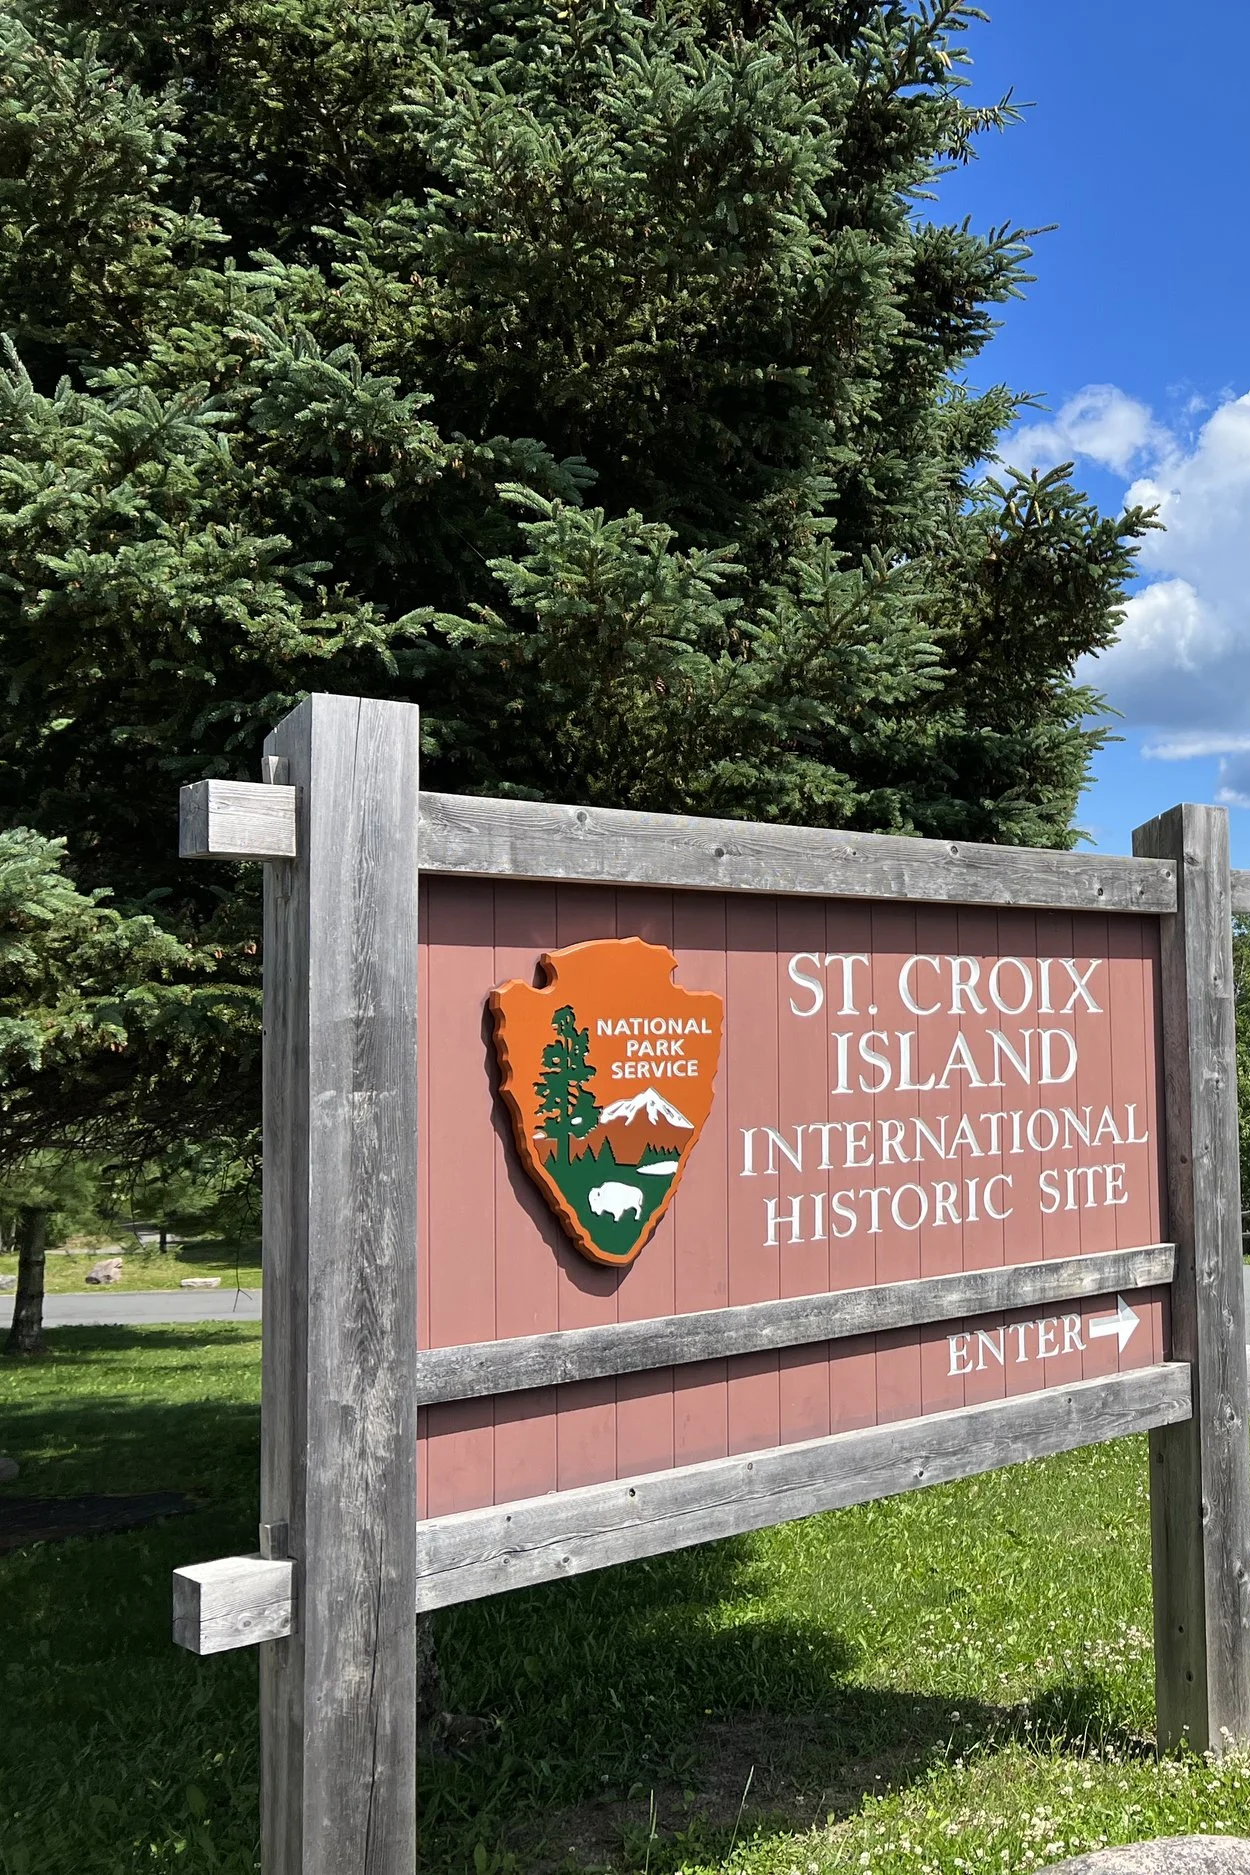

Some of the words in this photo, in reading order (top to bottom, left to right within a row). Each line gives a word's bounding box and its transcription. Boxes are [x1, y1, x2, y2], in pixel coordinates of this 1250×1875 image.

[788, 952, 878, 1017] ST.
[898, 955, 1103, 1016] CROIX
[596, 1016, 712, 1037] NATIONAL
[625, 1038, 685, 1057] PARK
[610, 1059, 699, 1079] SERVICE
[831, 1028, 1079, 1095] ISLAND
[739, 1103, 1149, 1177] INTERNATIONAL
[762, 1174, 1014, 1247] HISTORIC
[1038, 1162, 1129, 1214] SITE
[946, 1313, 1087, 1377] ENTER
